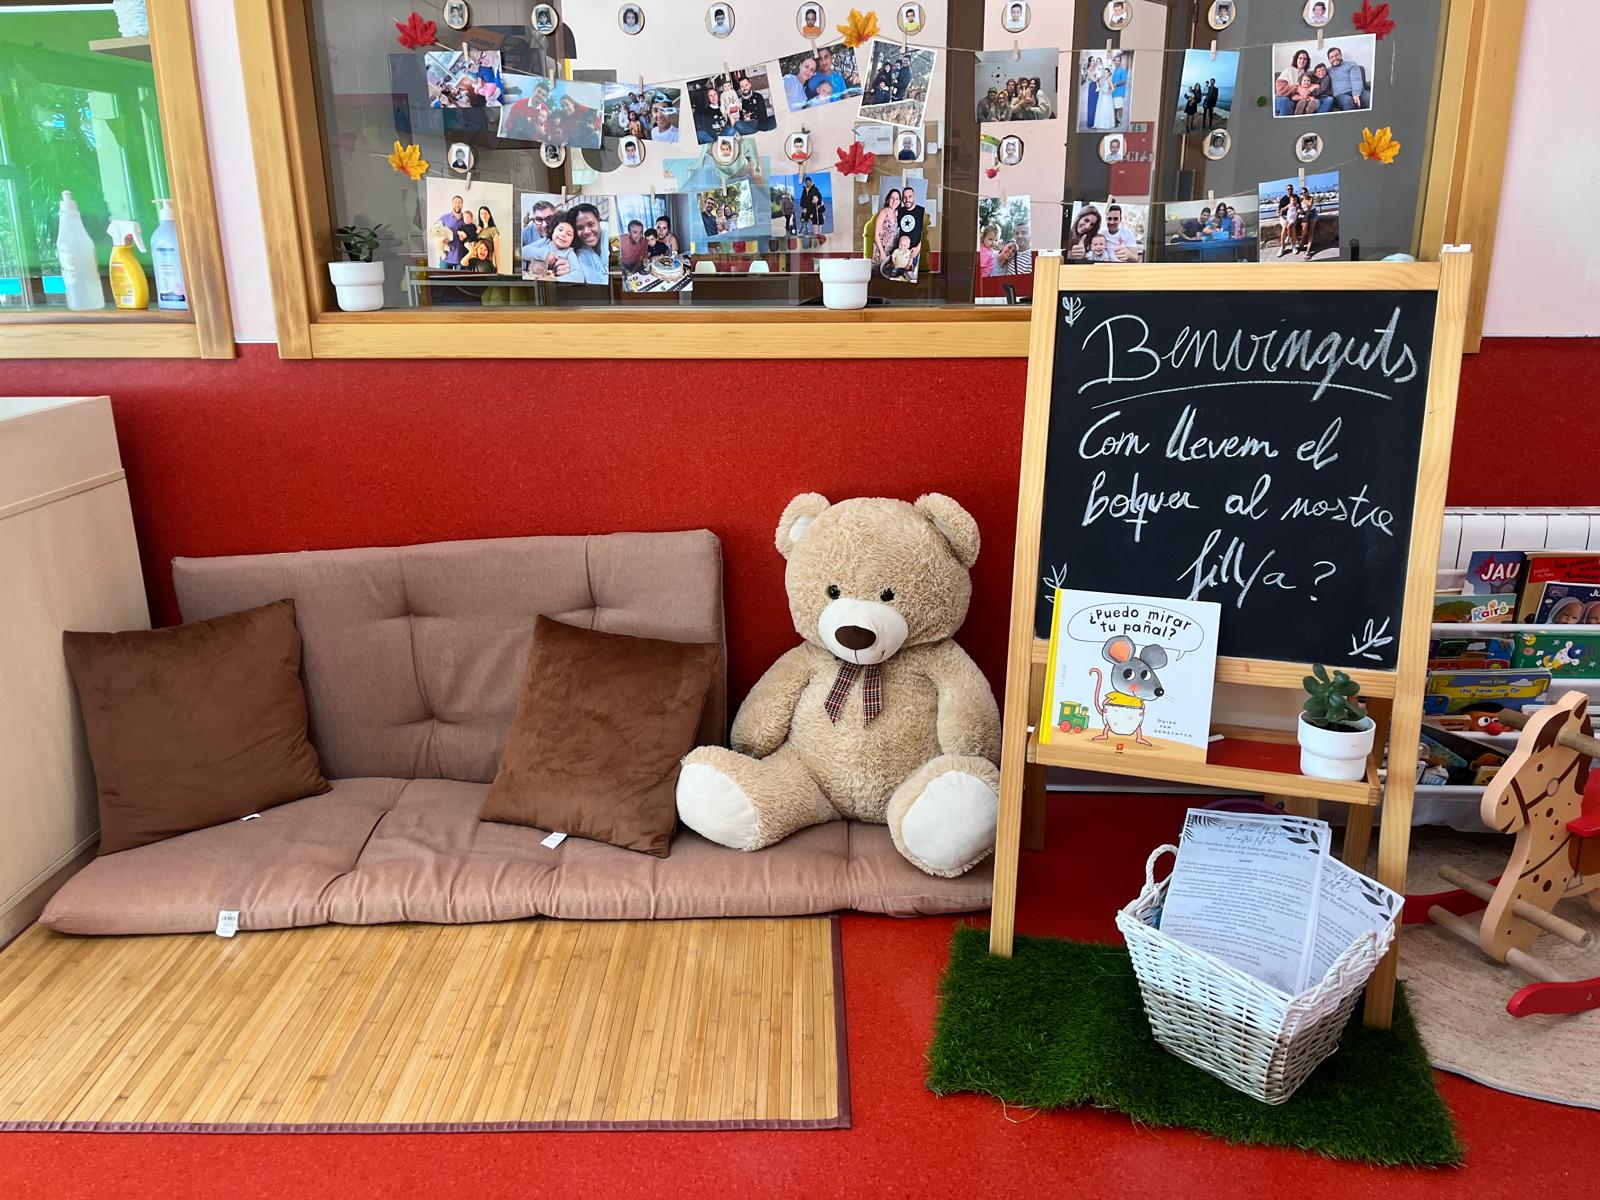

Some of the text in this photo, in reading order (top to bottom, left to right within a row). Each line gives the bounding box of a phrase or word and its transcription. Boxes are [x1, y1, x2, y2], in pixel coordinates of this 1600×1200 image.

[1078, 307, 1418, 401] Benvinguts
[1078, 404, 1342, 470] Com llevem el
[1225, 473, 1271, 519] al
[1281, 485, 1394, 537] nostre
[1089, 606, 1192, 630] ¿Puedo mirar
[1100, 621, 1177, 640] tu pañal?
